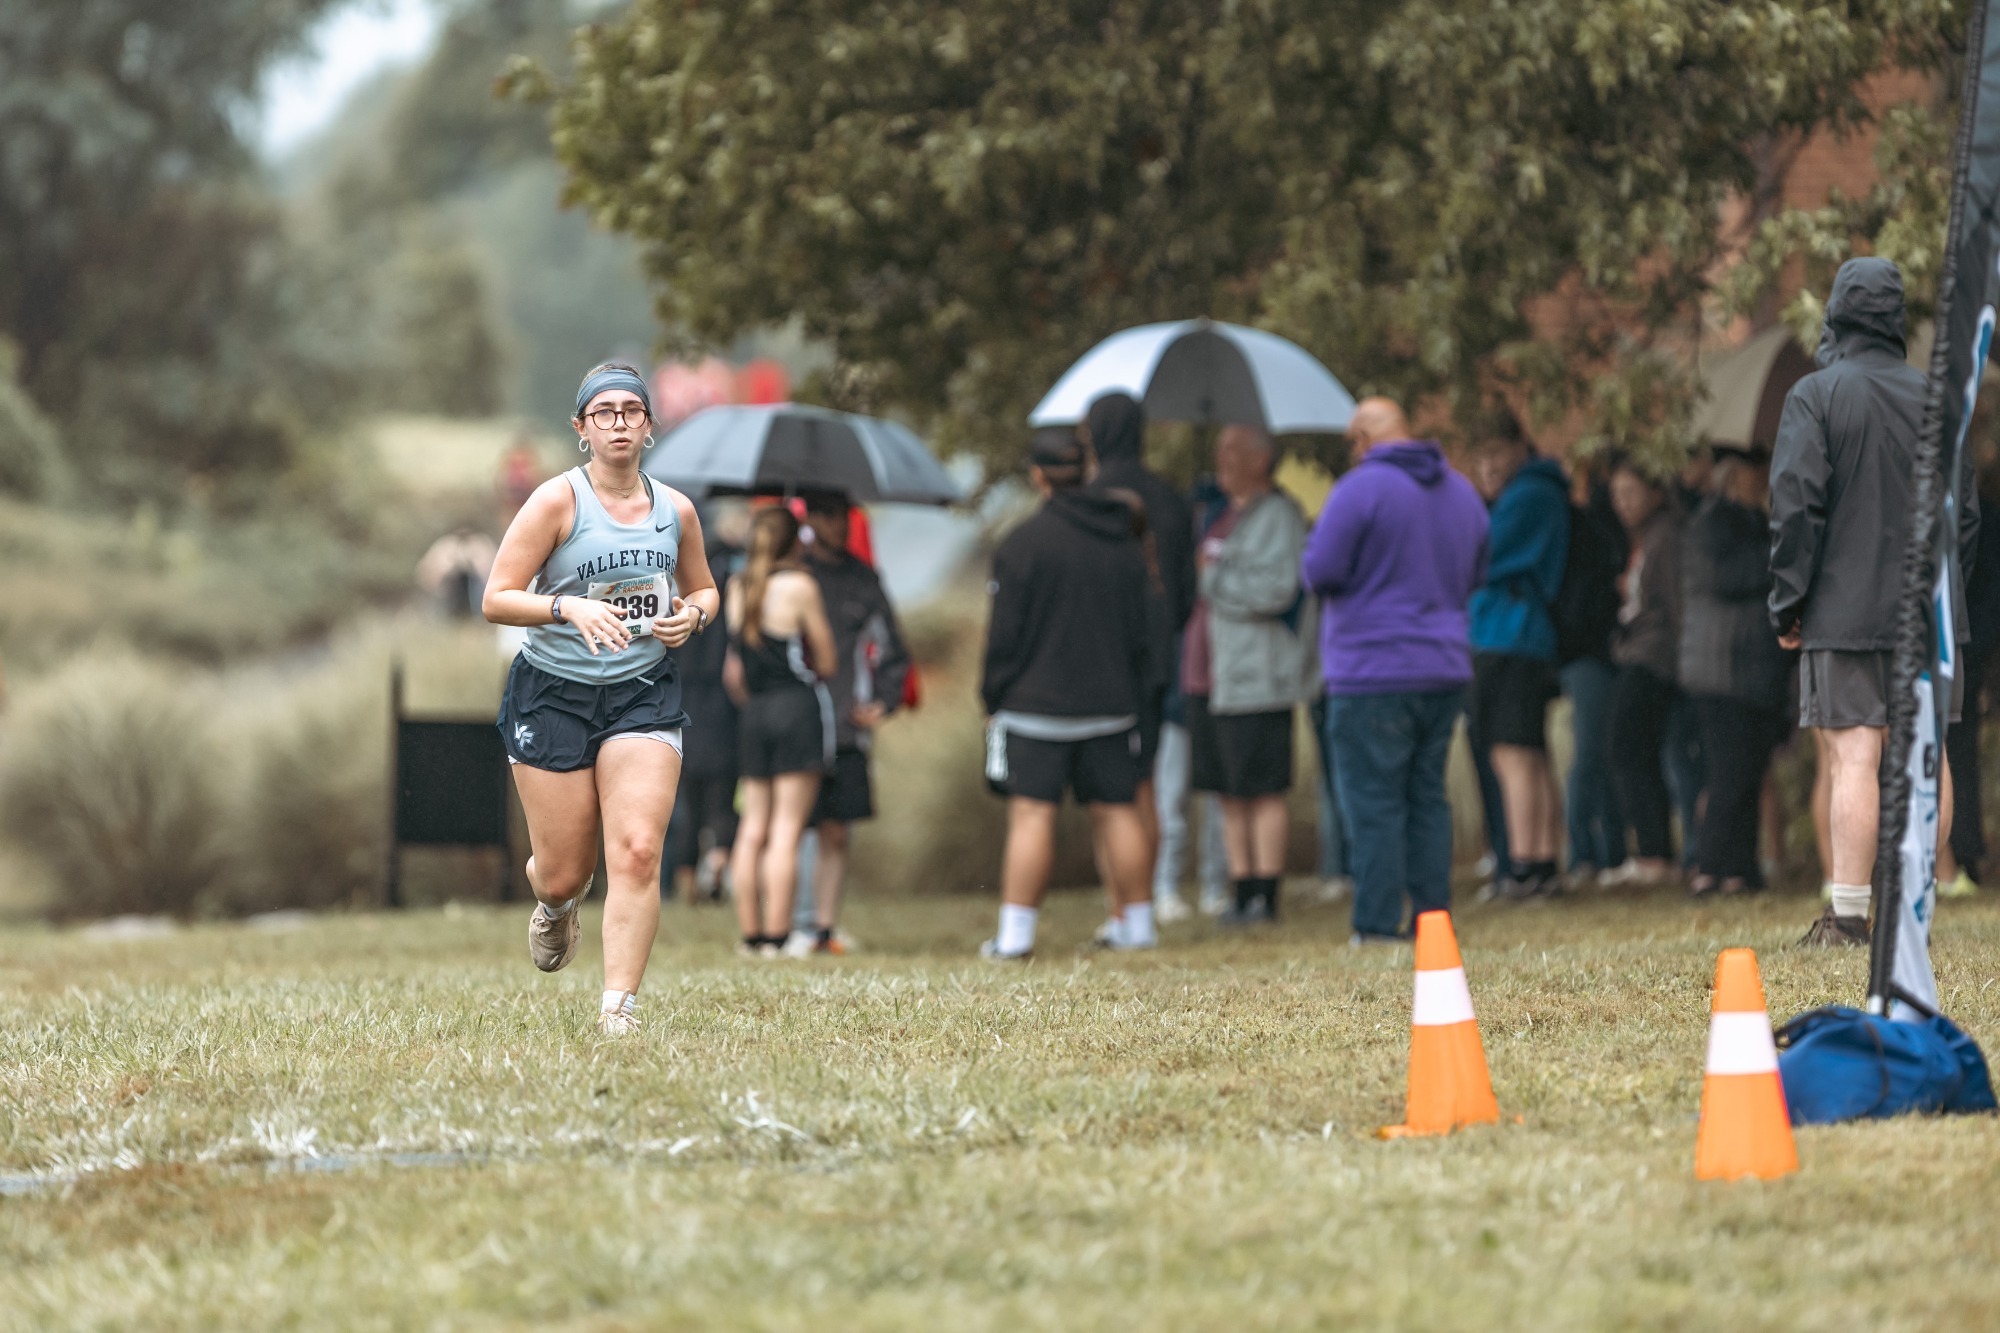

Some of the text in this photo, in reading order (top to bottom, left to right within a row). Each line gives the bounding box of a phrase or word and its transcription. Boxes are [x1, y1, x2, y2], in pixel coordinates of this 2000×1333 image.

[577, 549, 640, 581] VALLEY
[623, 577, 654, 587] BRYN MAWR
[623, 584, 645, 593] RACING
[600, 593, 658, 621] 039
